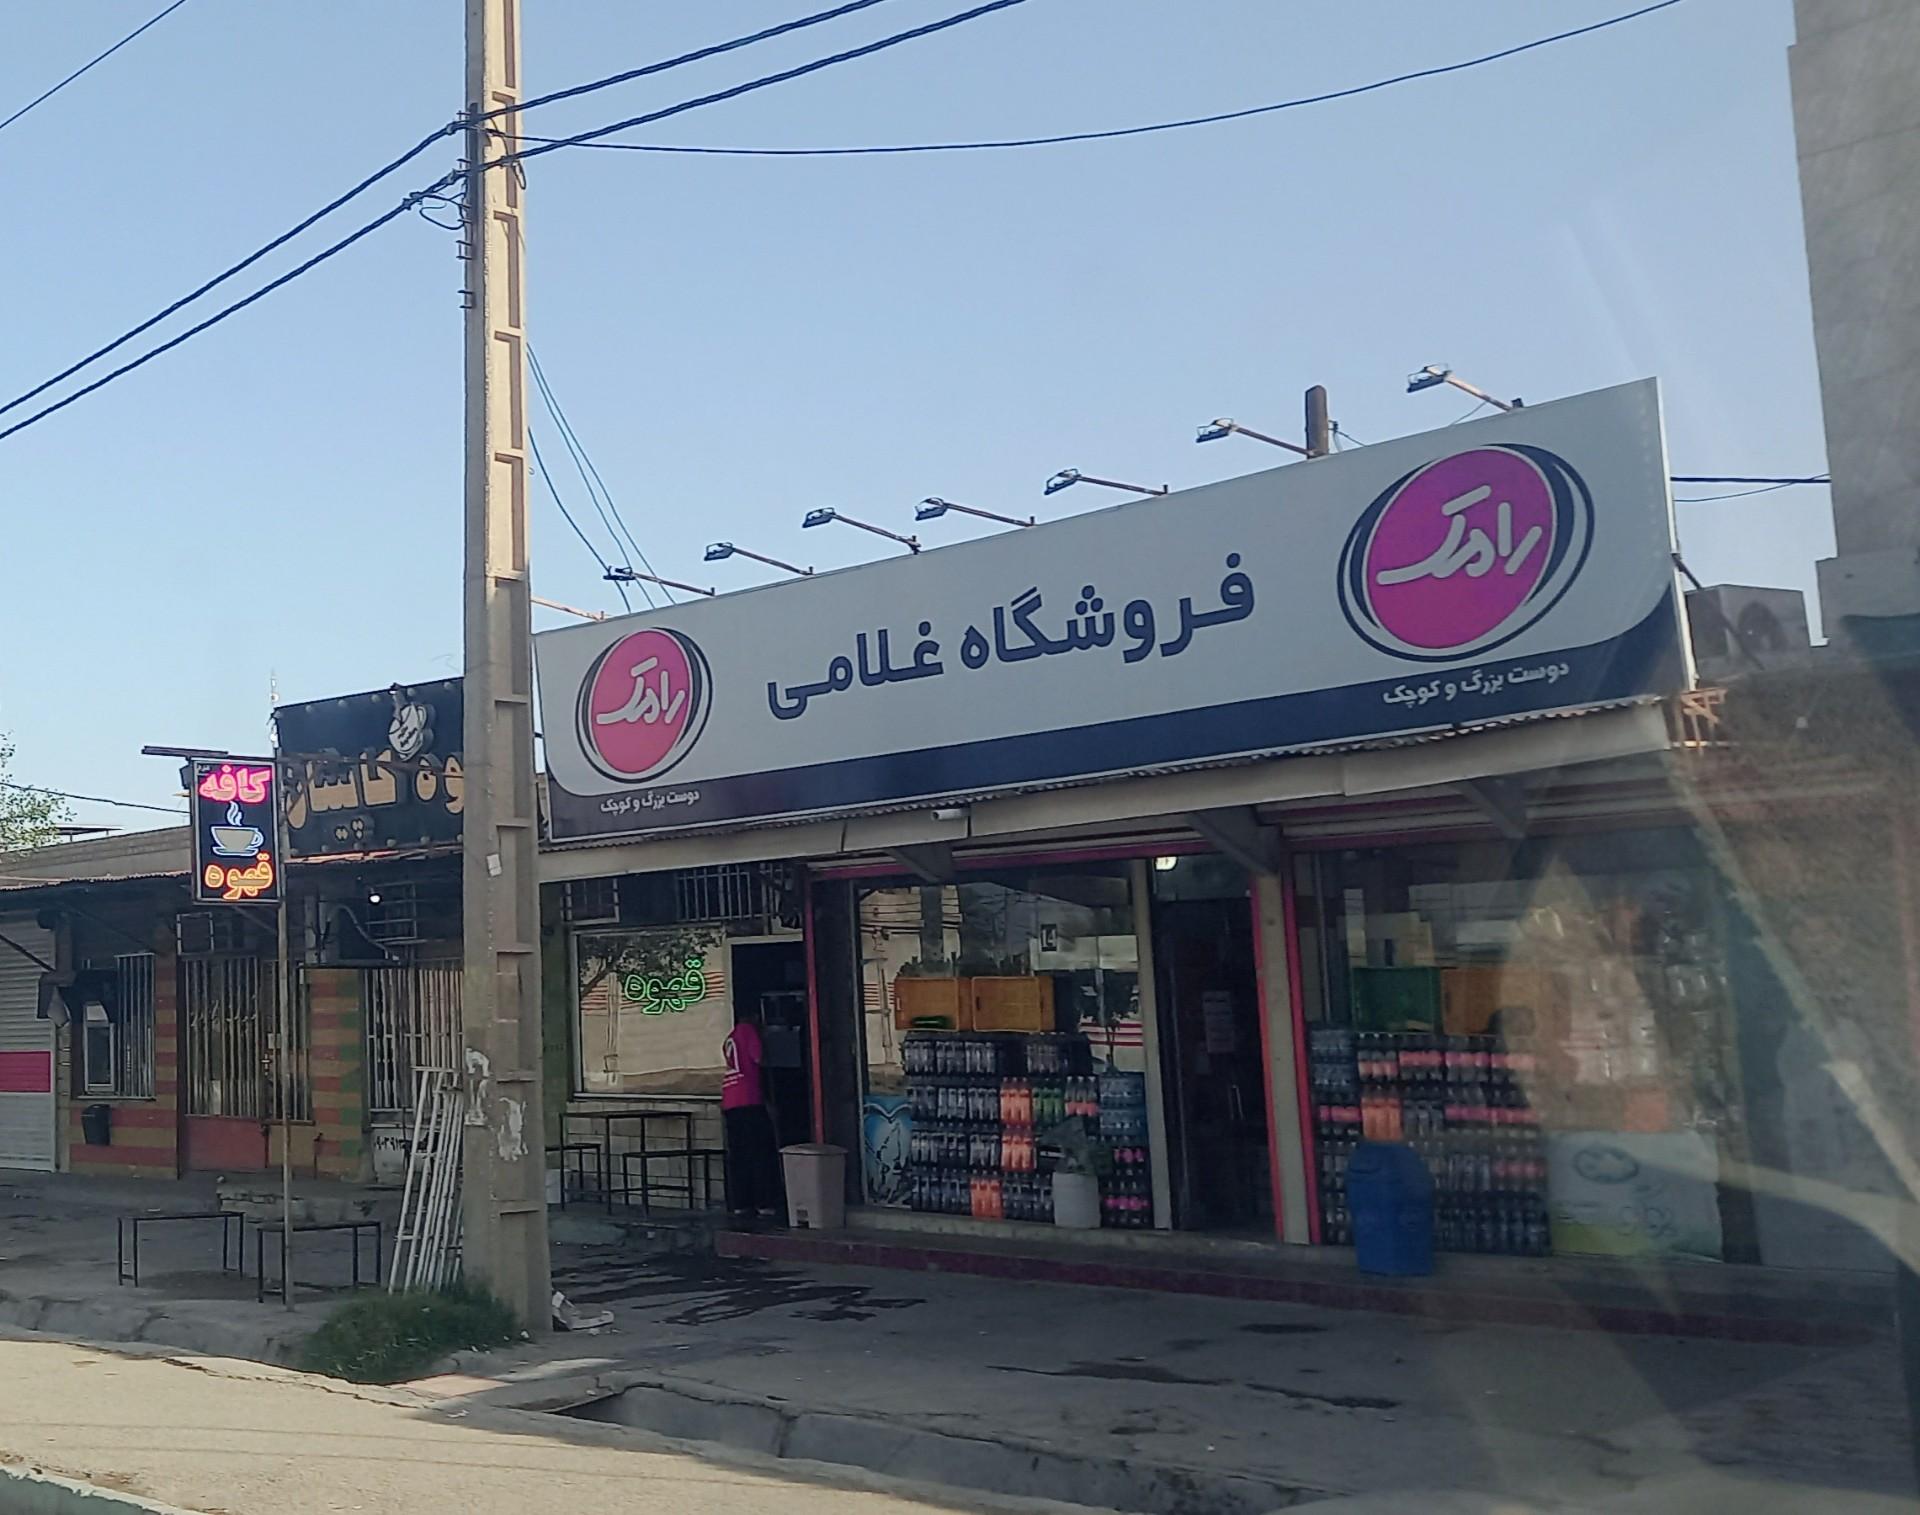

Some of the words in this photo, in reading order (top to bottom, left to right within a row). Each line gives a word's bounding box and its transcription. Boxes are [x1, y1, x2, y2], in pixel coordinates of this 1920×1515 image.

[1376, 484, 1542, 585] رامک
[960, 552, 1255, 670] فروشگاه
[766, 620, 944, 721] غلامی
[1460, 669, 1504, 695] بزرگ
[1507, 662, 1570, 684] دوست
[596, 656, 685, 726] رامک
[1382, 680, 1441, 709] کوچک
[1444, 682, 1457, 701] و
[198, 763, 271, 804] کافه
[666, 790, 700, 806] دوست
[600, 796, 632, 816] کوچک
[632, 799, 640, 812] و
[641, 790, 666, 810] بزرگ
[204, 851, 274, 900] قهوه
[624, 957, 706, 1015] قهوه
